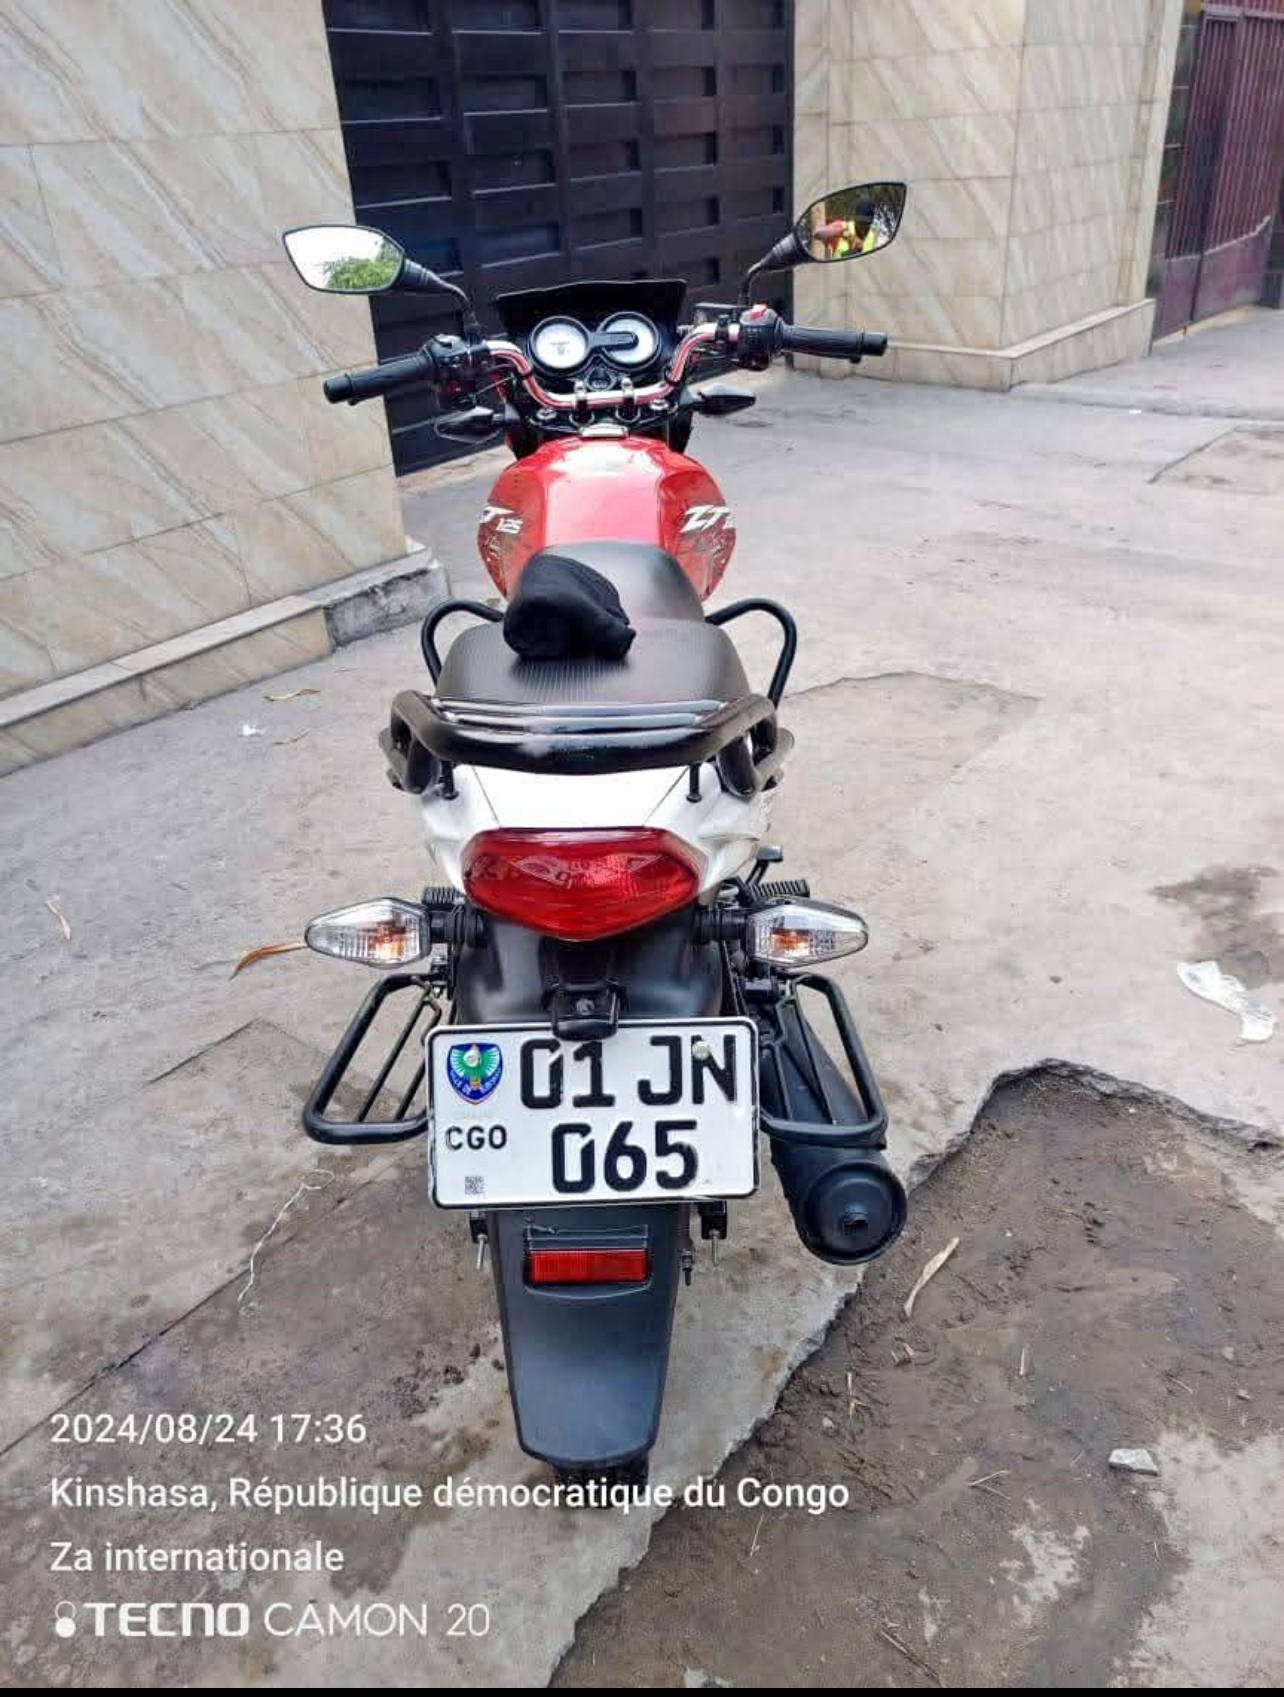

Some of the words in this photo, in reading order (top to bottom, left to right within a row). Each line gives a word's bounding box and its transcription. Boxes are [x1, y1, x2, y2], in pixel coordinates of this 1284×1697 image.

[520, 1037, 616, 1110] 01
[637, 1034, 737, 1106] JN
[445, 1124, 507, 1151] CGO
[551, 1119, 699, 1194] 065
